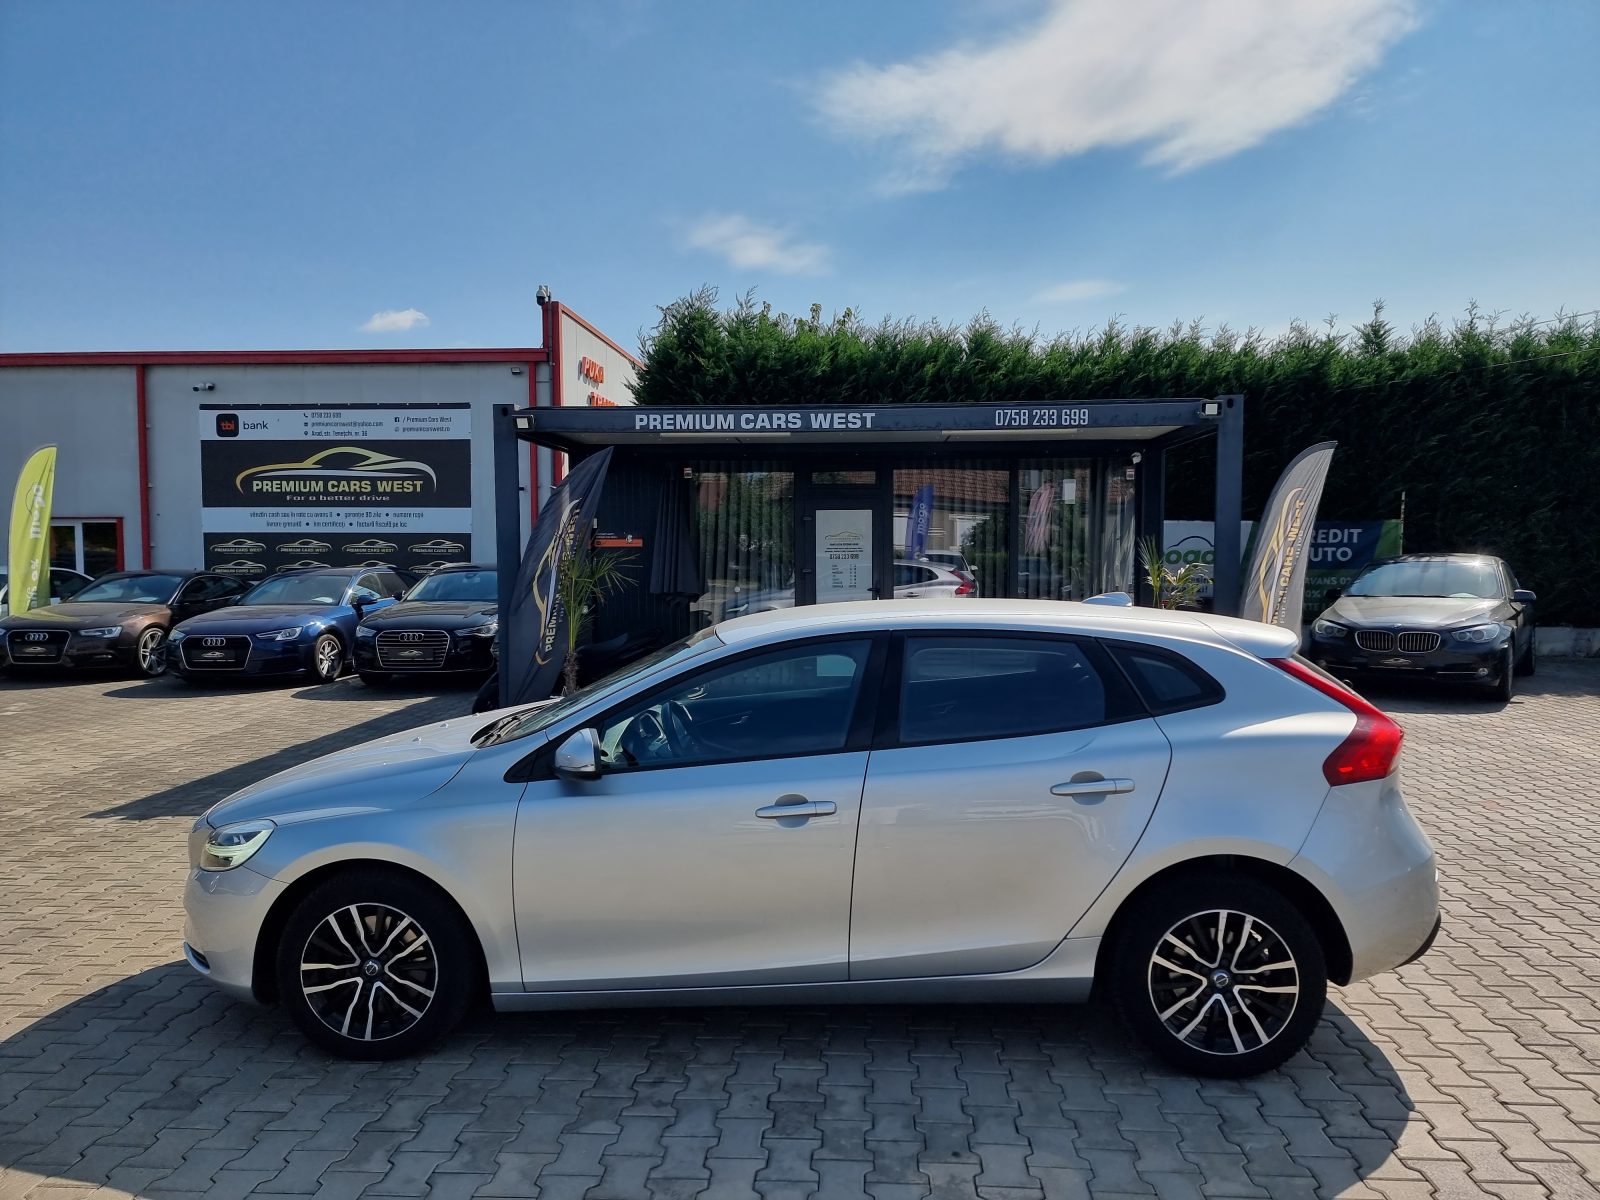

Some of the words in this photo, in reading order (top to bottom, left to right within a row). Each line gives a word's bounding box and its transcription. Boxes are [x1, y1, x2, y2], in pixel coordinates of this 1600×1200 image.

[635, 413, 735, 430] PREMIUM
[740, 412, 802, 430] CARS
[809, 412, 876, 429] WEST
[995, 409, 1029, 426] 0758
[1032, 409, 1057, 426] 233
[1061, 408, 1089, 426] 699
[243, 420, 269, 430] bank
[252, 480, 324, 493] PREMIUM
[327, 480, 372, 493] CARS
[376, 480, 424, 493] WEST
